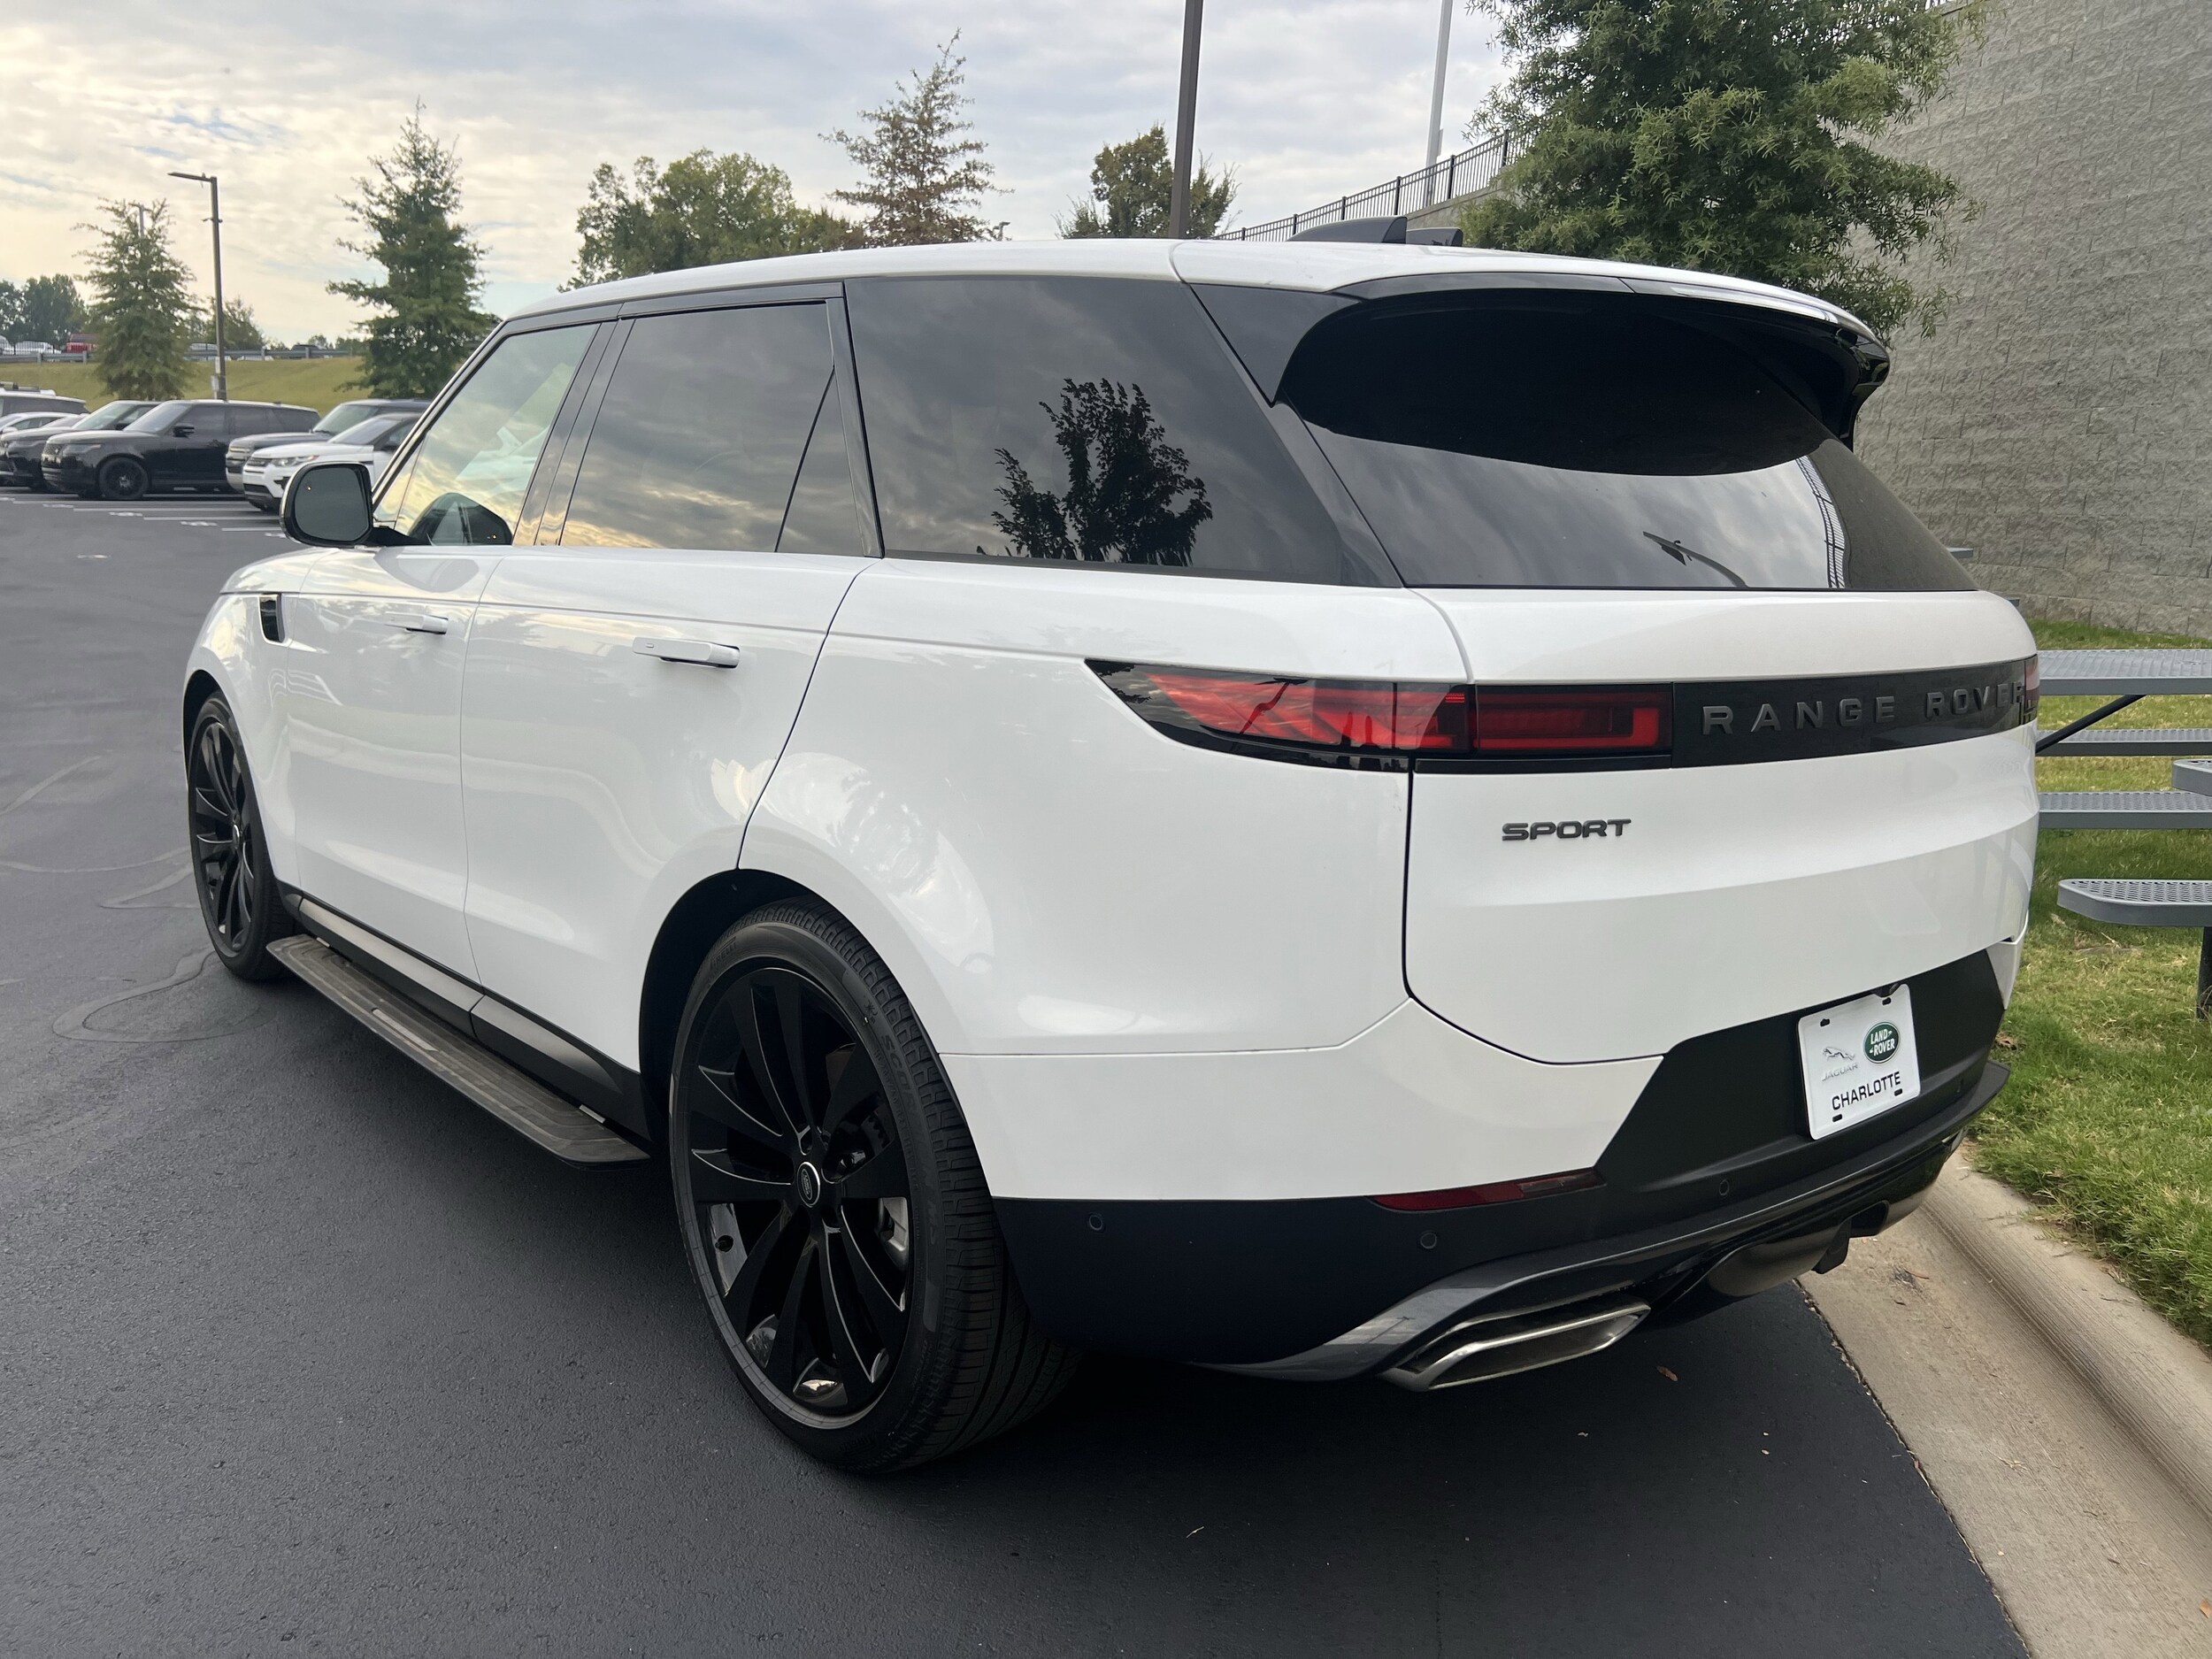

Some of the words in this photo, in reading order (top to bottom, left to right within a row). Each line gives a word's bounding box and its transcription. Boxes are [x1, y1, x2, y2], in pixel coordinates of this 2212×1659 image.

[1701, 695, 1895, 734] RANGE
[1924, 681, 2024, 718] ROVER
[1502, 818, 1632, 841] SPORT
[1870, 1029, 1888, 1044] LAND
[1873, 1038, 1895, 1056] ROVER
[1822, 1064, 1858, 1081] JAGUAR
[1832, 1071, 1901, 1110] CHARLOTTE
